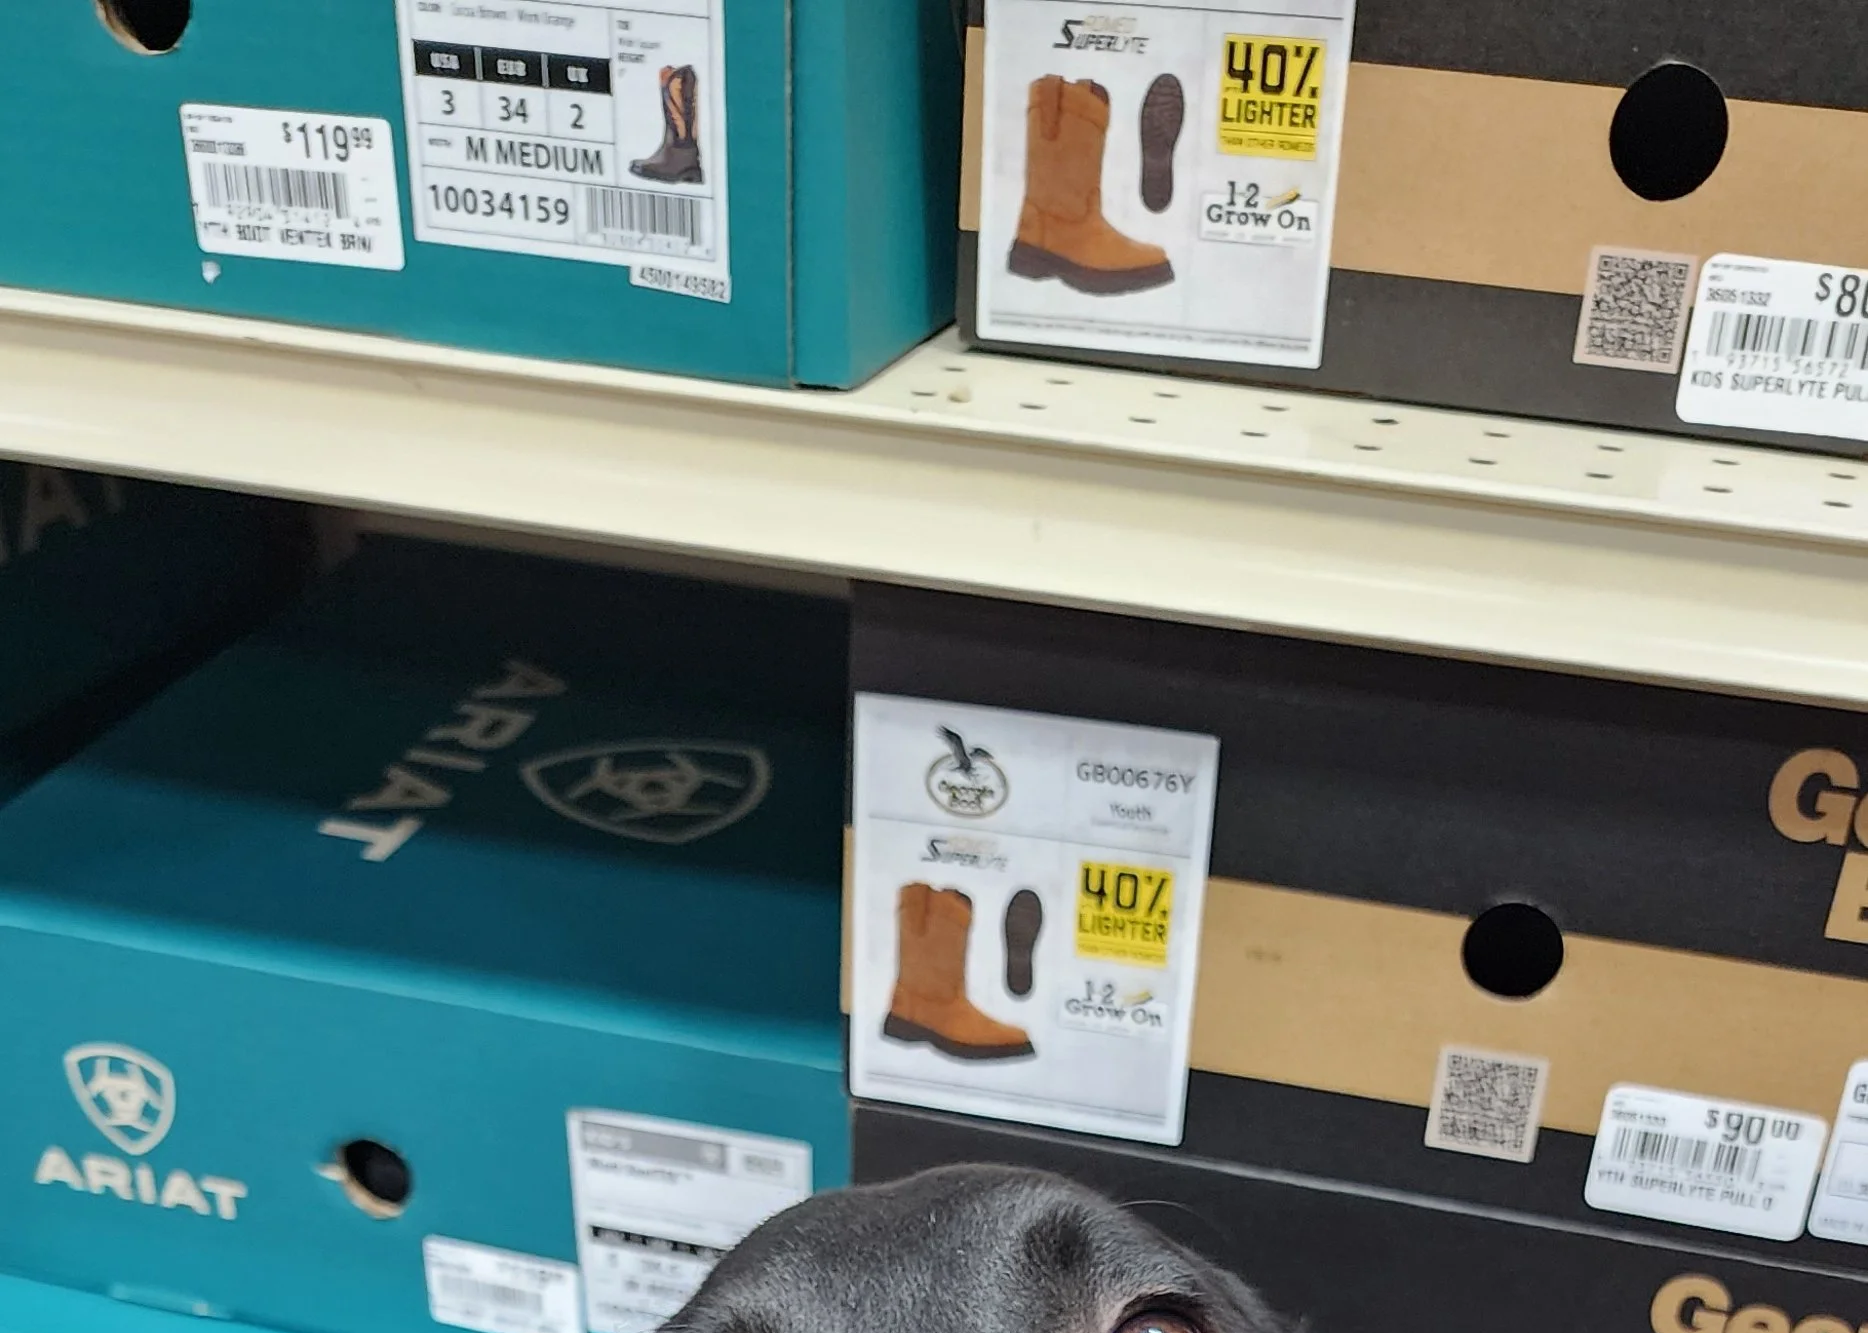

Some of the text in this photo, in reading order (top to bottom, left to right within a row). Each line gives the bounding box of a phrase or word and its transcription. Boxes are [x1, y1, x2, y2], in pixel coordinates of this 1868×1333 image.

[1227, 41, 1320, 99] 40%
[441, 89, 456, 116] 3
[497, 95, 529, 123] 34
[570, 103, 585, 130] 2
[1220, 98, 1317, 129] LIGHTER
[466, 135, 605, 177] M MEDIUM
[428, 184, 571, 226] 10034159
[1206, 203, 1312, 232] Grow On
[1730, 373, 1828, 400] SUPERLYTE
[316, 660, 567, 863] ARIAT
[1076, 761, 1196, 796] GB00676Y
[1081, 867, 1168, 921] 40%
[1079, 913, 1166, 944] LIGHTER
[1131, 1007, 1163, 1028] On
[35, 1147, 248, 1221] ARIAT
